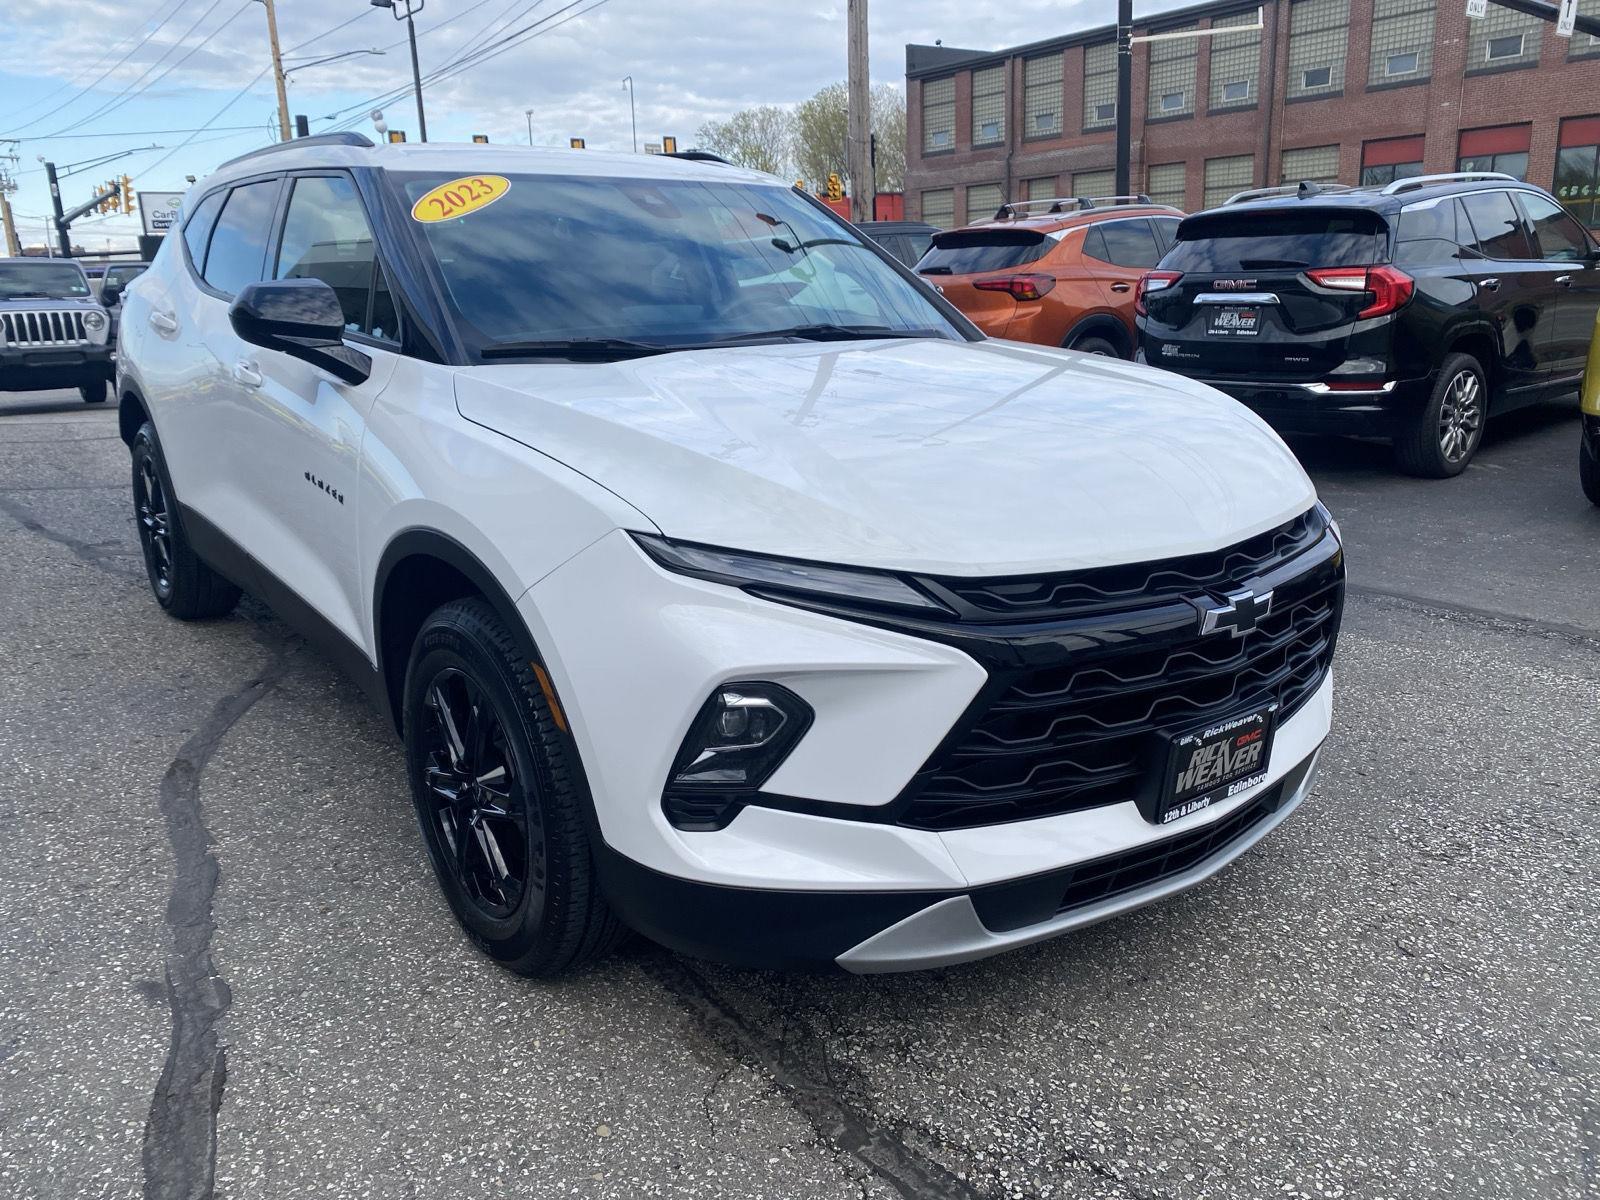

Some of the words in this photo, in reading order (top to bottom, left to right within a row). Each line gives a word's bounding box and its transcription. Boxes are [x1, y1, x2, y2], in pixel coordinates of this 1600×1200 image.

[1469, 1, 1484, 13] ONLY
[428, 178, 494, 217] 2023
[1213, 279, 1257, 290] GMC
[1214, 317, 1256, 327] WEAVER
[1220, 312, 1240, 321] RICK
[1189, 738, 1234, 768] RICK
[1236, 729, 1263, 747] GMC
[1175, 740, 1264, 794] WEAVER
[1227, 773, 1267, 797] Edinboro
[1163, 808, 1181, 824] 12th
[1180, 805, 1188, 817] &
[1187, 796, 1211, 813] Liberty
